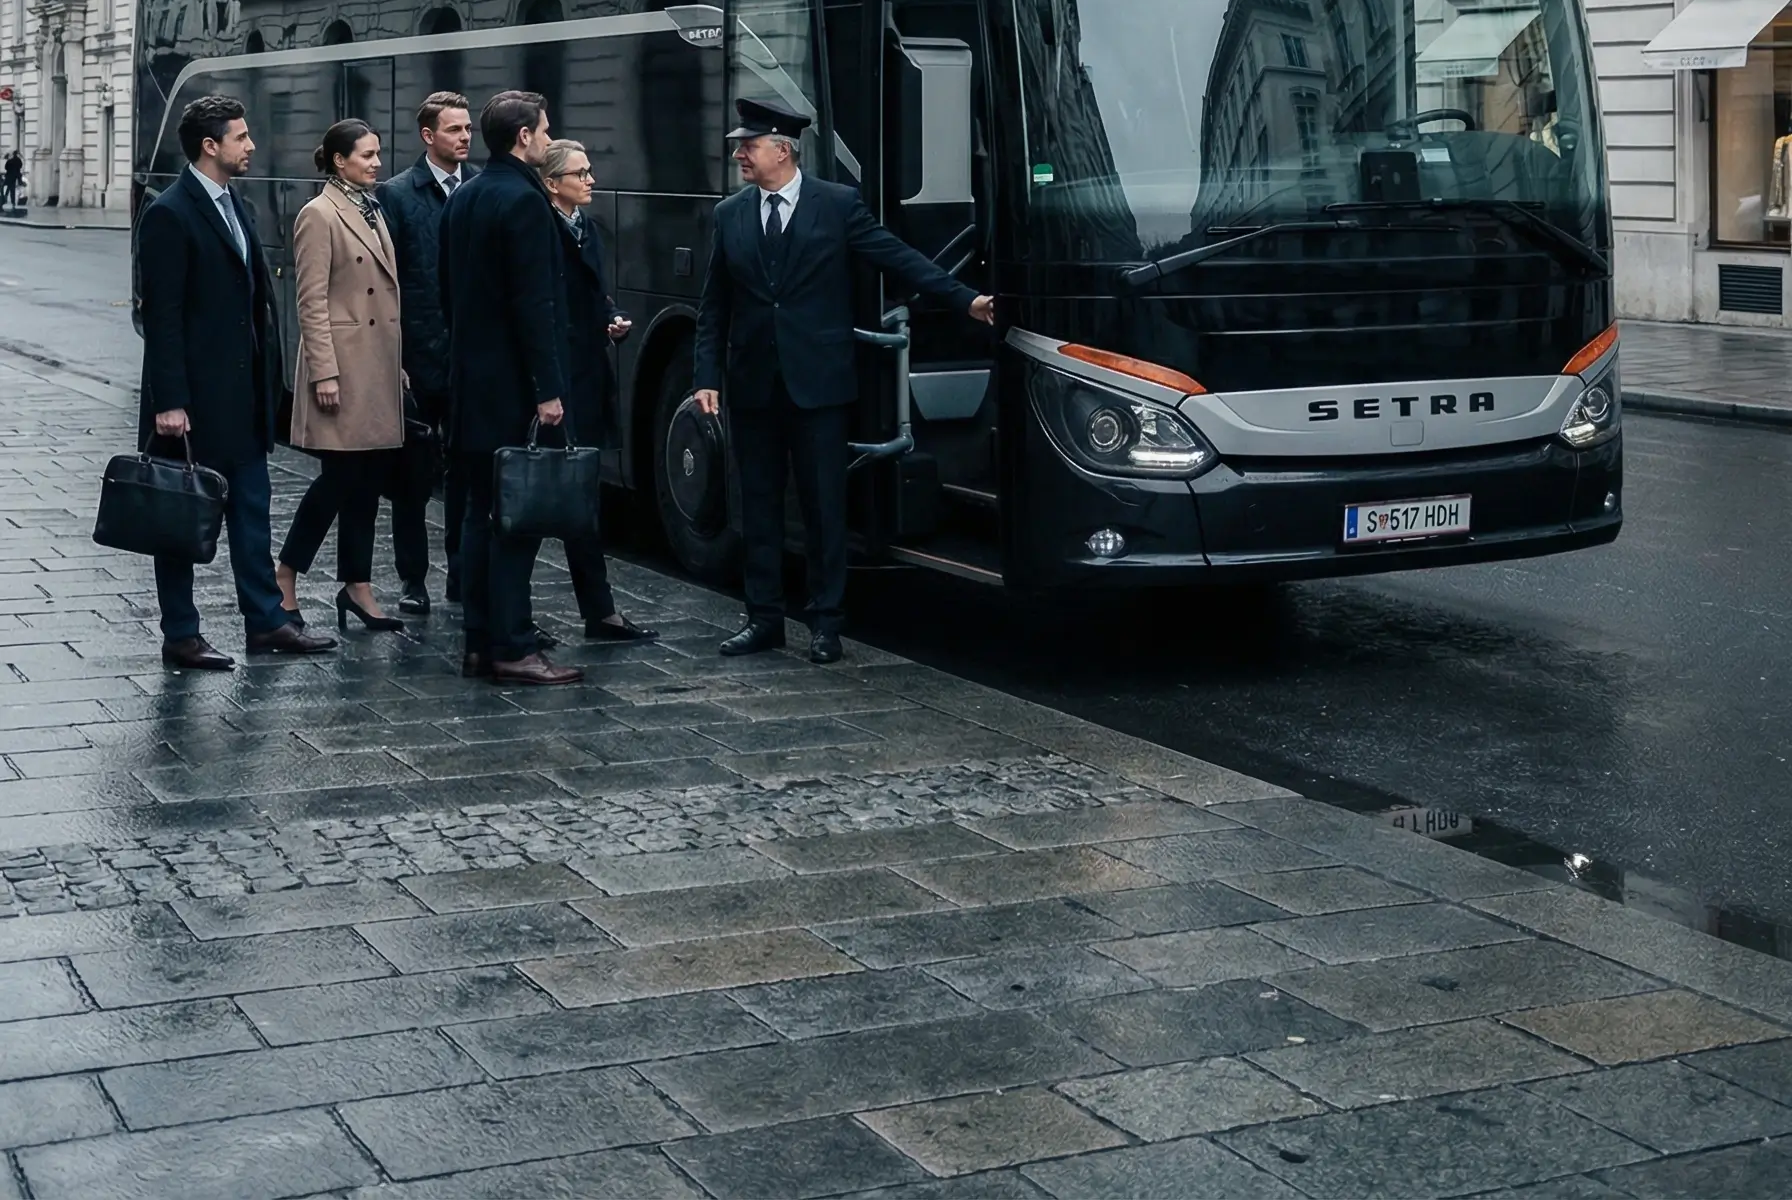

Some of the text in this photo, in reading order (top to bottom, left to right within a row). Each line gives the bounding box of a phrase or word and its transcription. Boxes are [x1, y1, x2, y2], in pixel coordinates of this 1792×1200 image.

[1308, 392, 1495, 422] SETRA
[1390, 507, 1420, 531] 517
[1424, 503, 1459, 527] HDH
